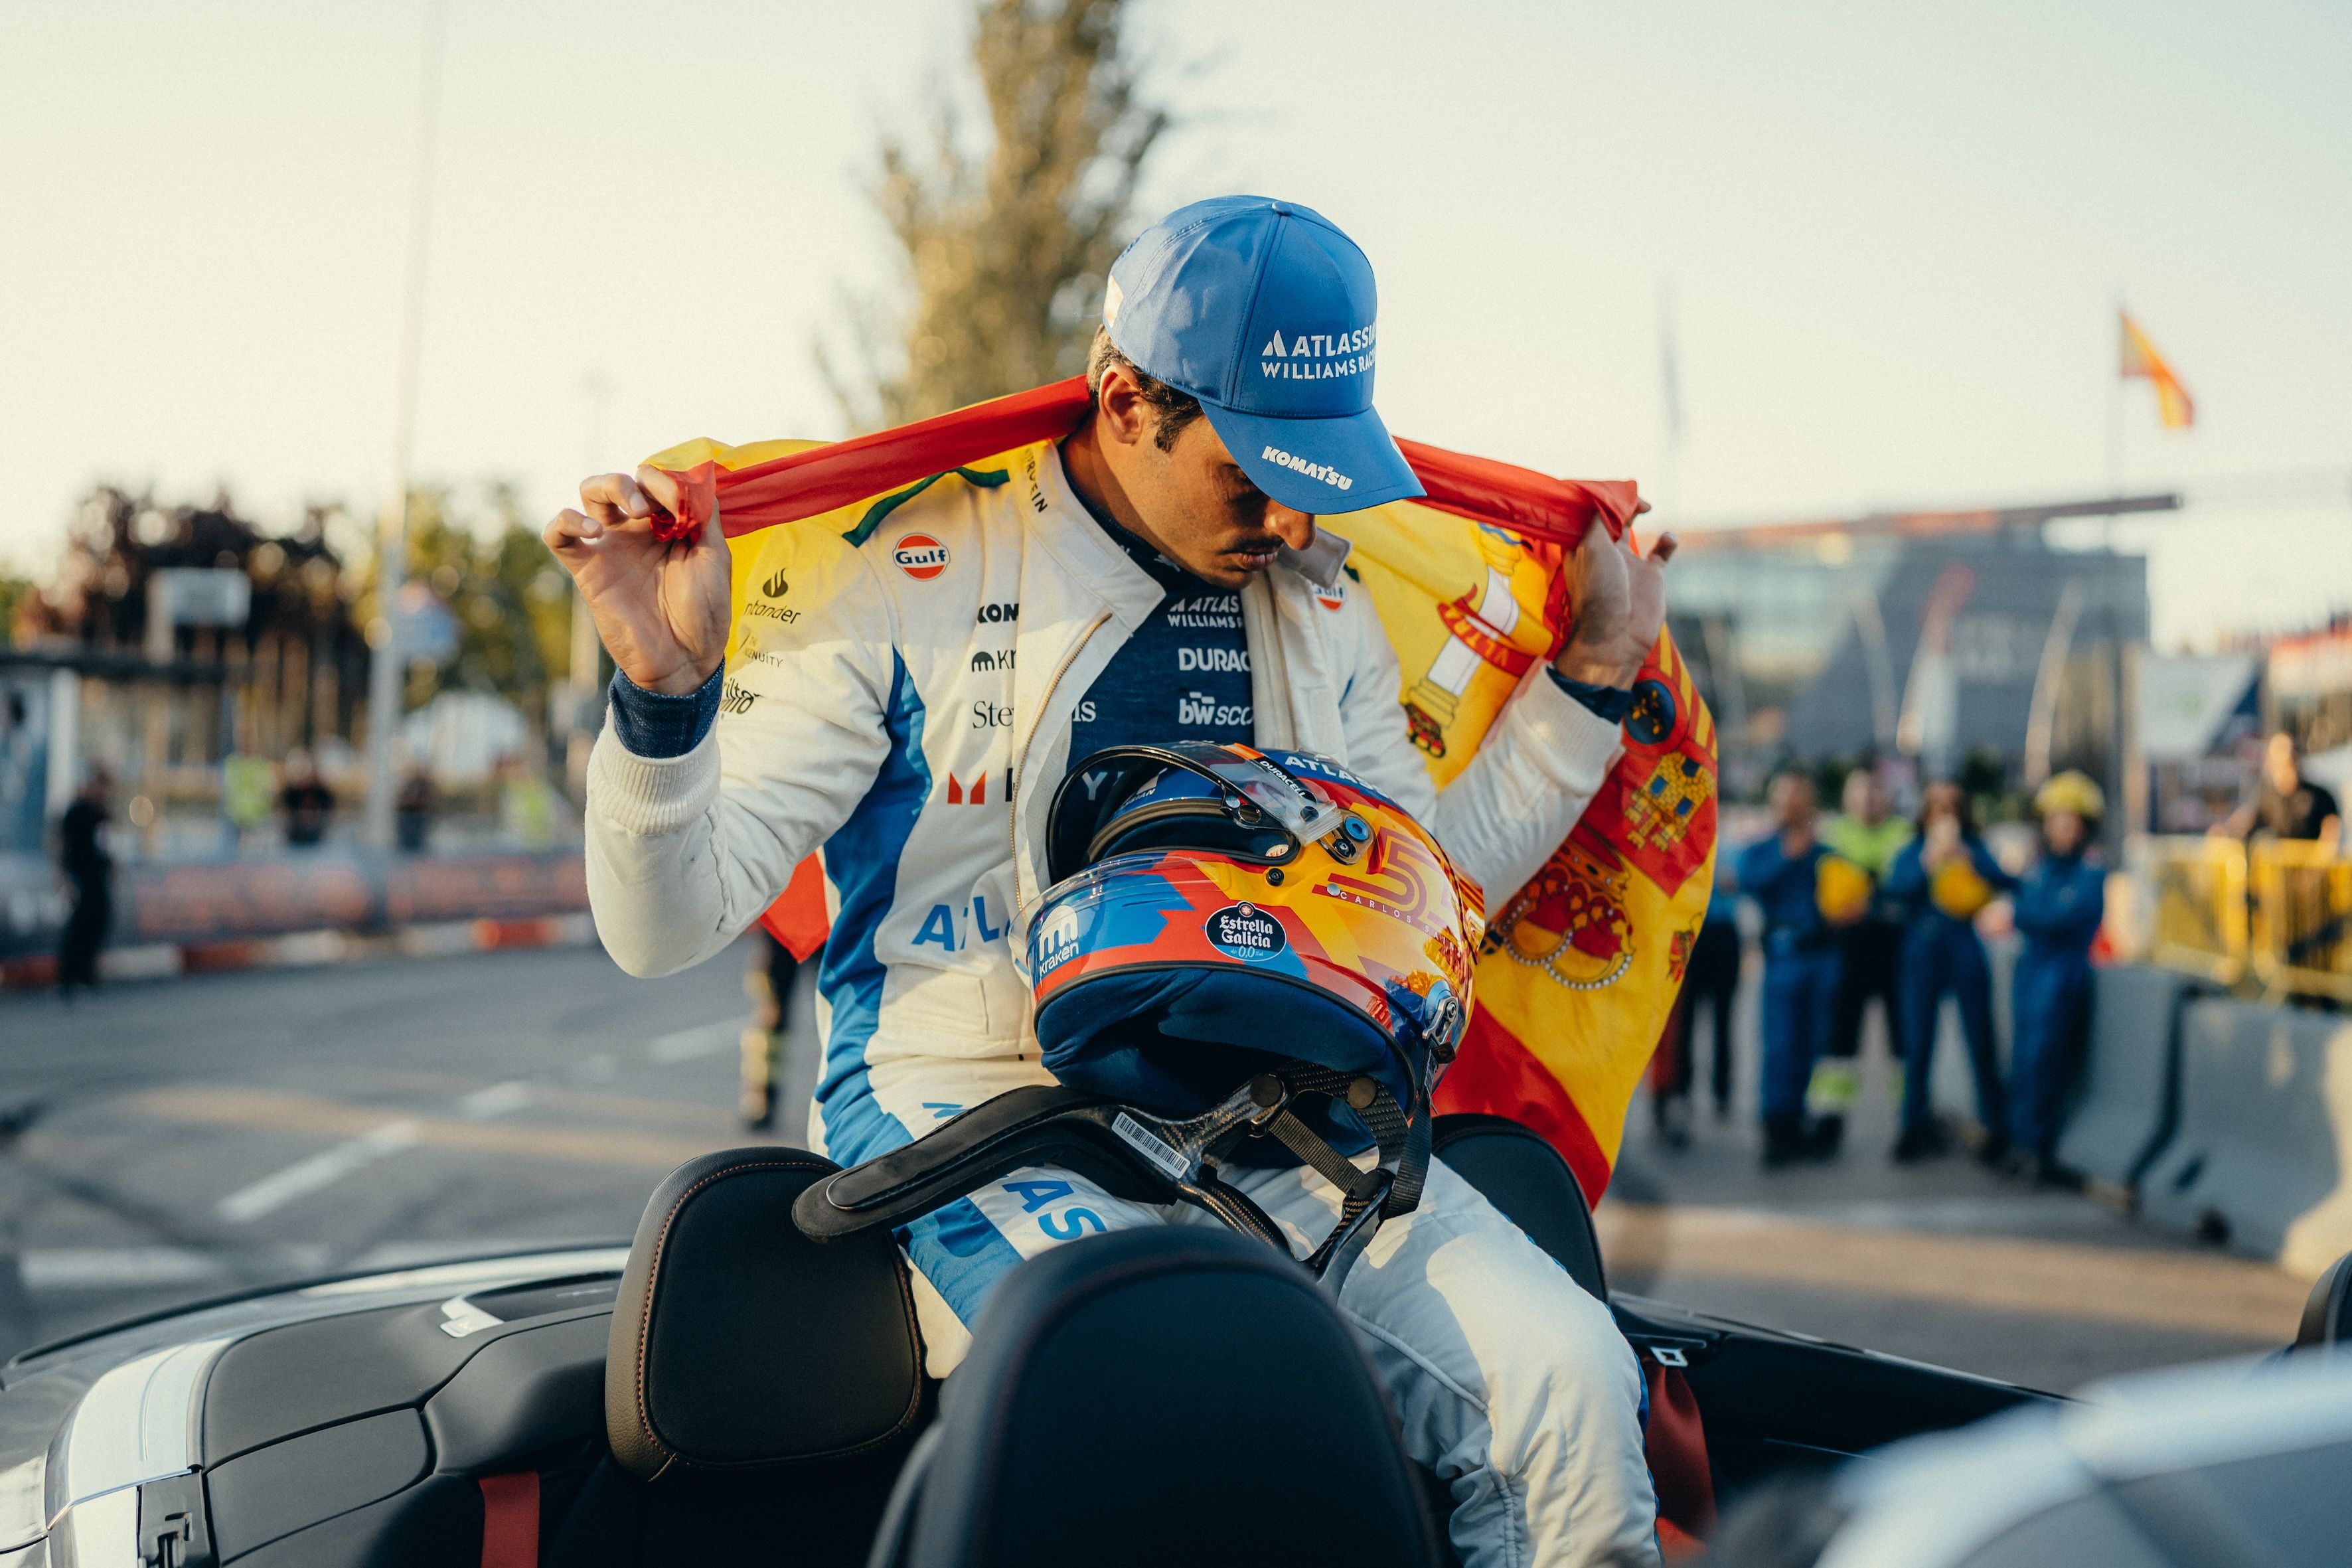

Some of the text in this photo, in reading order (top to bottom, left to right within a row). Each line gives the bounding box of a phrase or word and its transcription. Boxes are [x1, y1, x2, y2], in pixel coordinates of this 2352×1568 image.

[1261, 358, 1357, 380] WILLIAMS
[1261, 445, 1353, 491] KOMATSU
[896, 549, 946, 564] Gulf
[1167, 614, 1236, 628] WILLIAMS
[973, 700, 1014, 733] Ste
[1340, 892, 1411, 923] CARLOS
[1219, 915, 1274, 935] Estrella
[1221, 929, 1271, 948] Galicia
[1040, 942, 1079, 979] kraken
